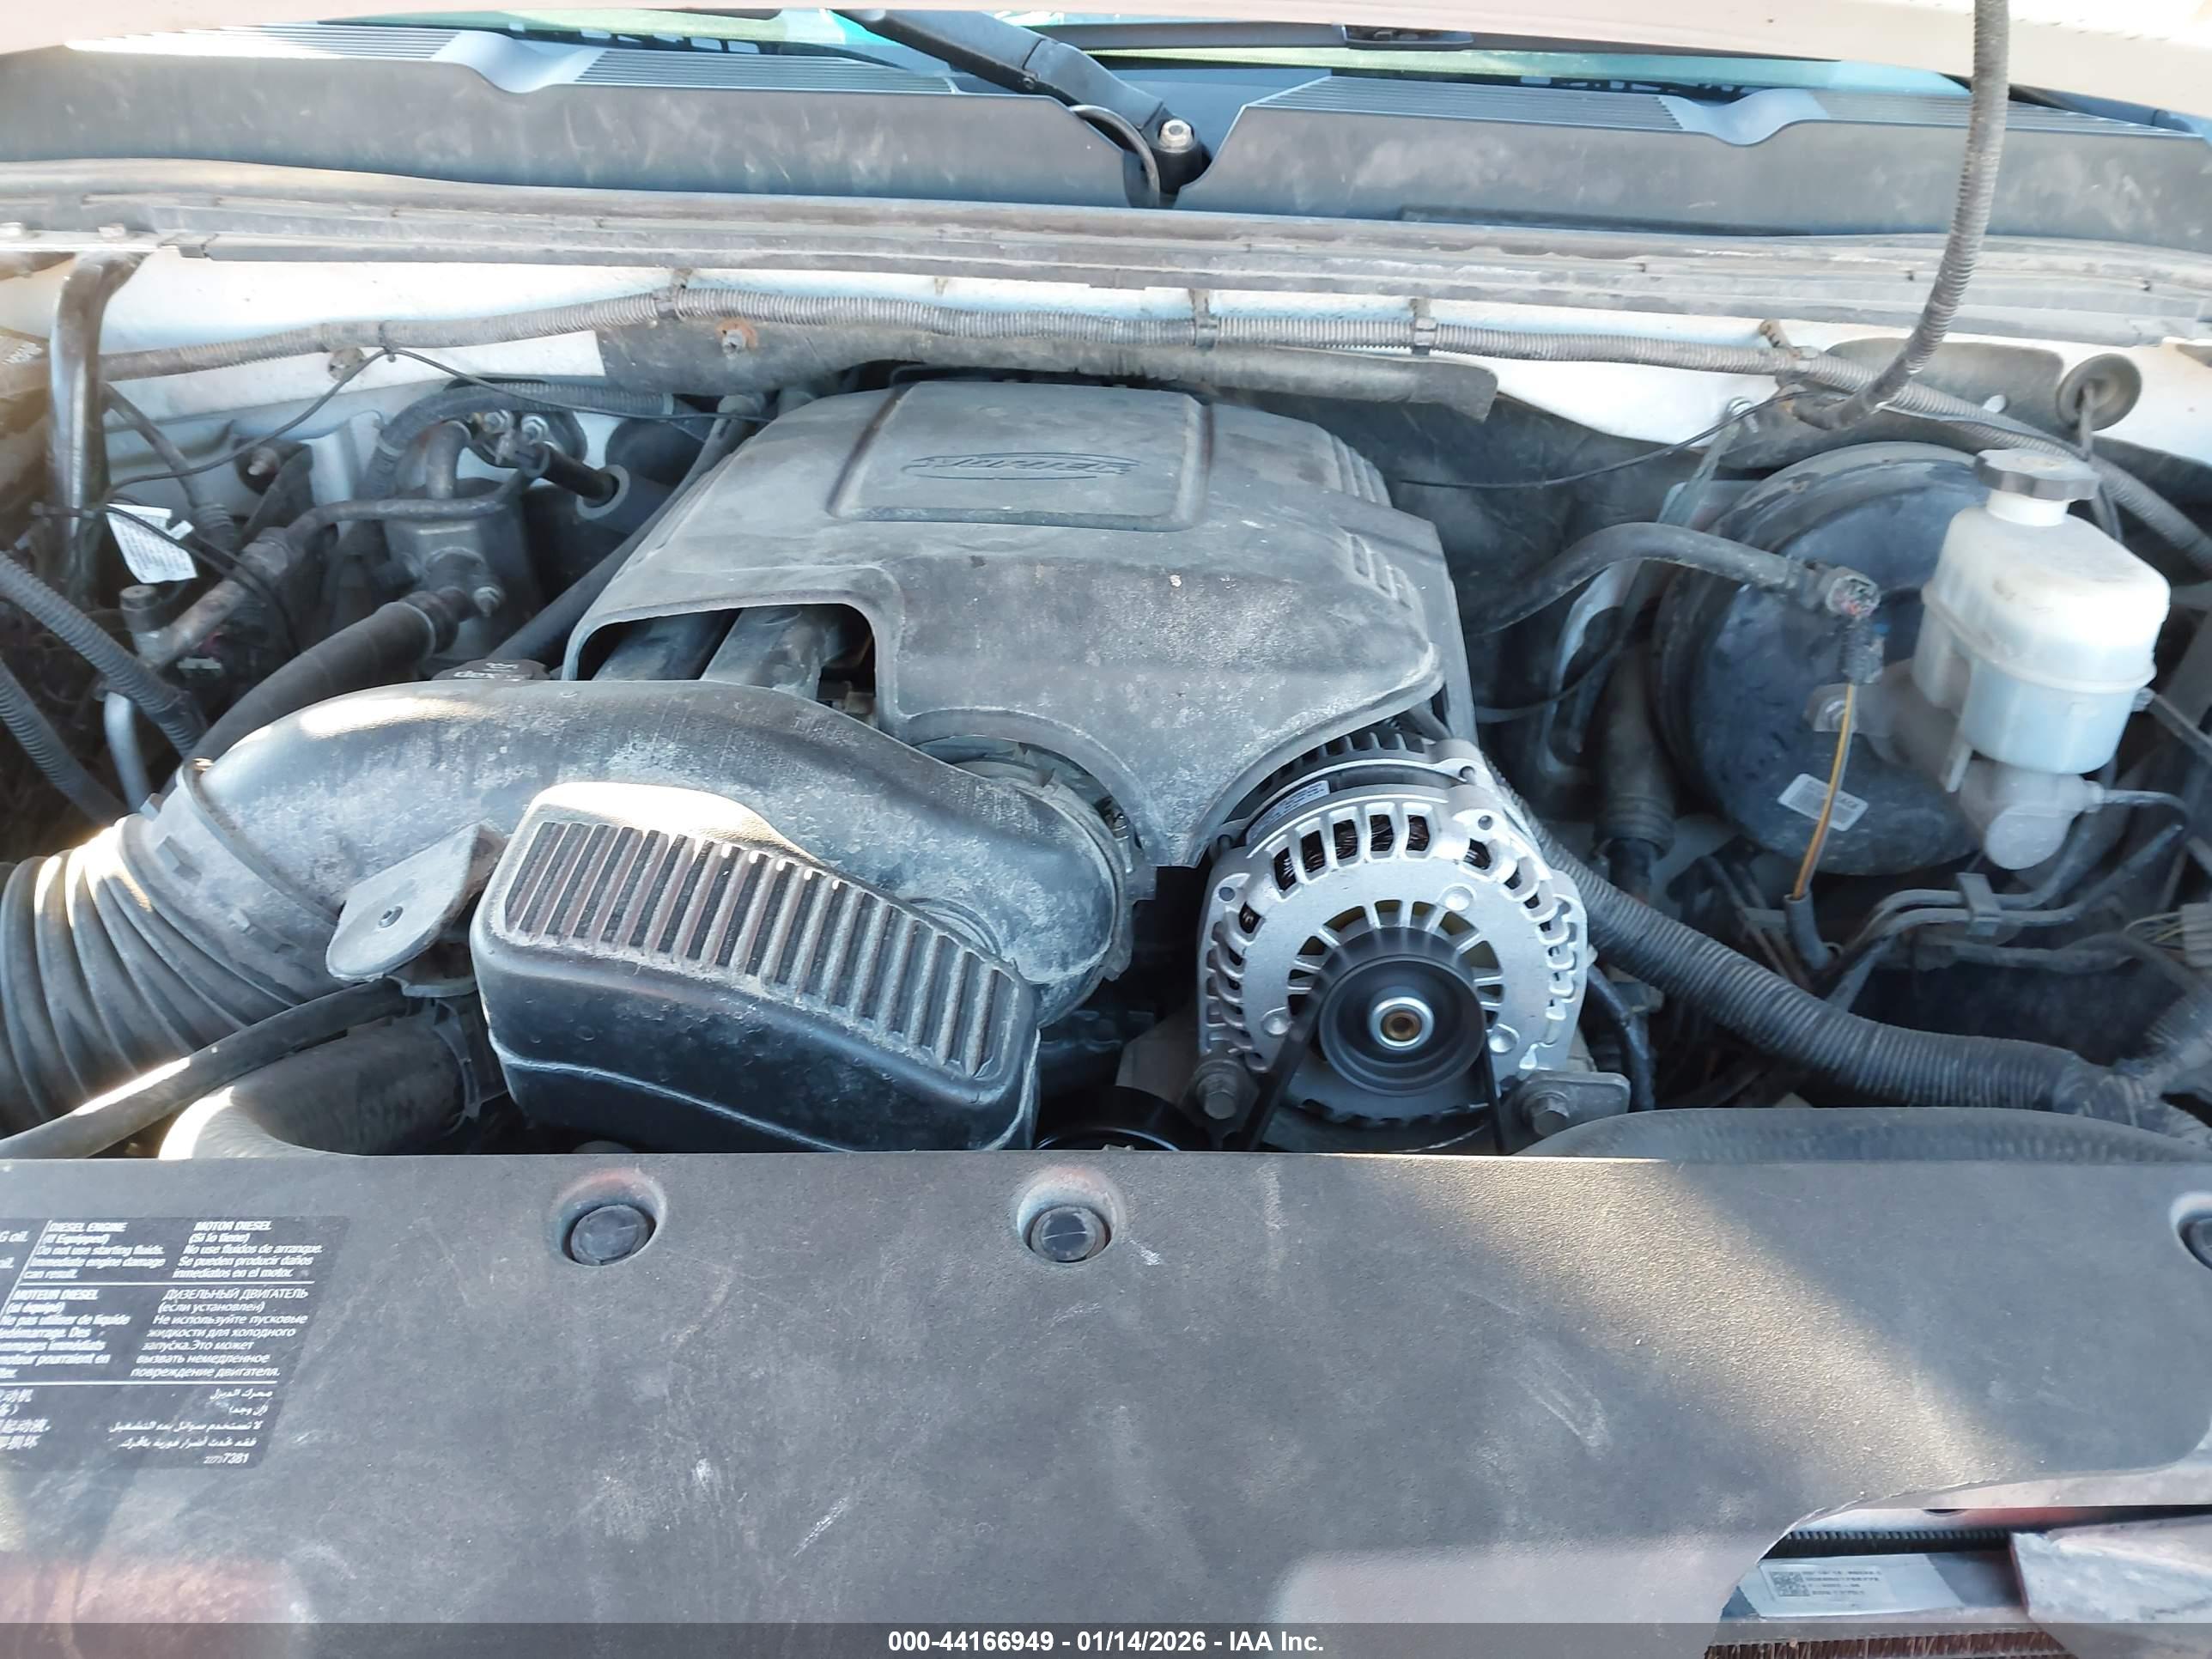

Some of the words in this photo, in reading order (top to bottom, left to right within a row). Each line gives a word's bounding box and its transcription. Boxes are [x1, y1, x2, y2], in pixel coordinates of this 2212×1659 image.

[48, 1223, 86, 1232] DIESEL
[86, 1223, 127, 1232] ENGINE
[193, 1221, 234, 1231] MOTOR
[234, 1221, 271, 1231] DIESEL
[258, 1244, 272, 1254] de
[178, 1256, 194, 1267] Se
[60, 1290, 99, 1300] DIESEL
[162, 1288, 240, 1300] ДИЗЕЛЬНЫЙ
[240, 1288, 308, 1300] ДВИГАТЕЛЬ
[158, 1301, 190, 1313] (если
[191, 1301, 265, 1314] установлен)
[152, 1315, 169, 1324] Не
[172, 1314, 247, 1326] используйте
[249, 1315, 308, 1326] пусковые
[147, 1328, 205, 1339] жидкости
[206, 1328, 230, 1339] для
[231, 1328, 296, 1339] холодного
[214, 1341, 254, 1351] может
[137, 1355, 185, 1364] вызвать
[186, 1354, 270, 1365] немедленное
[131, 1367, 215, 1379] повреждение
[215, 1367, 281, 1379] двигателя.
